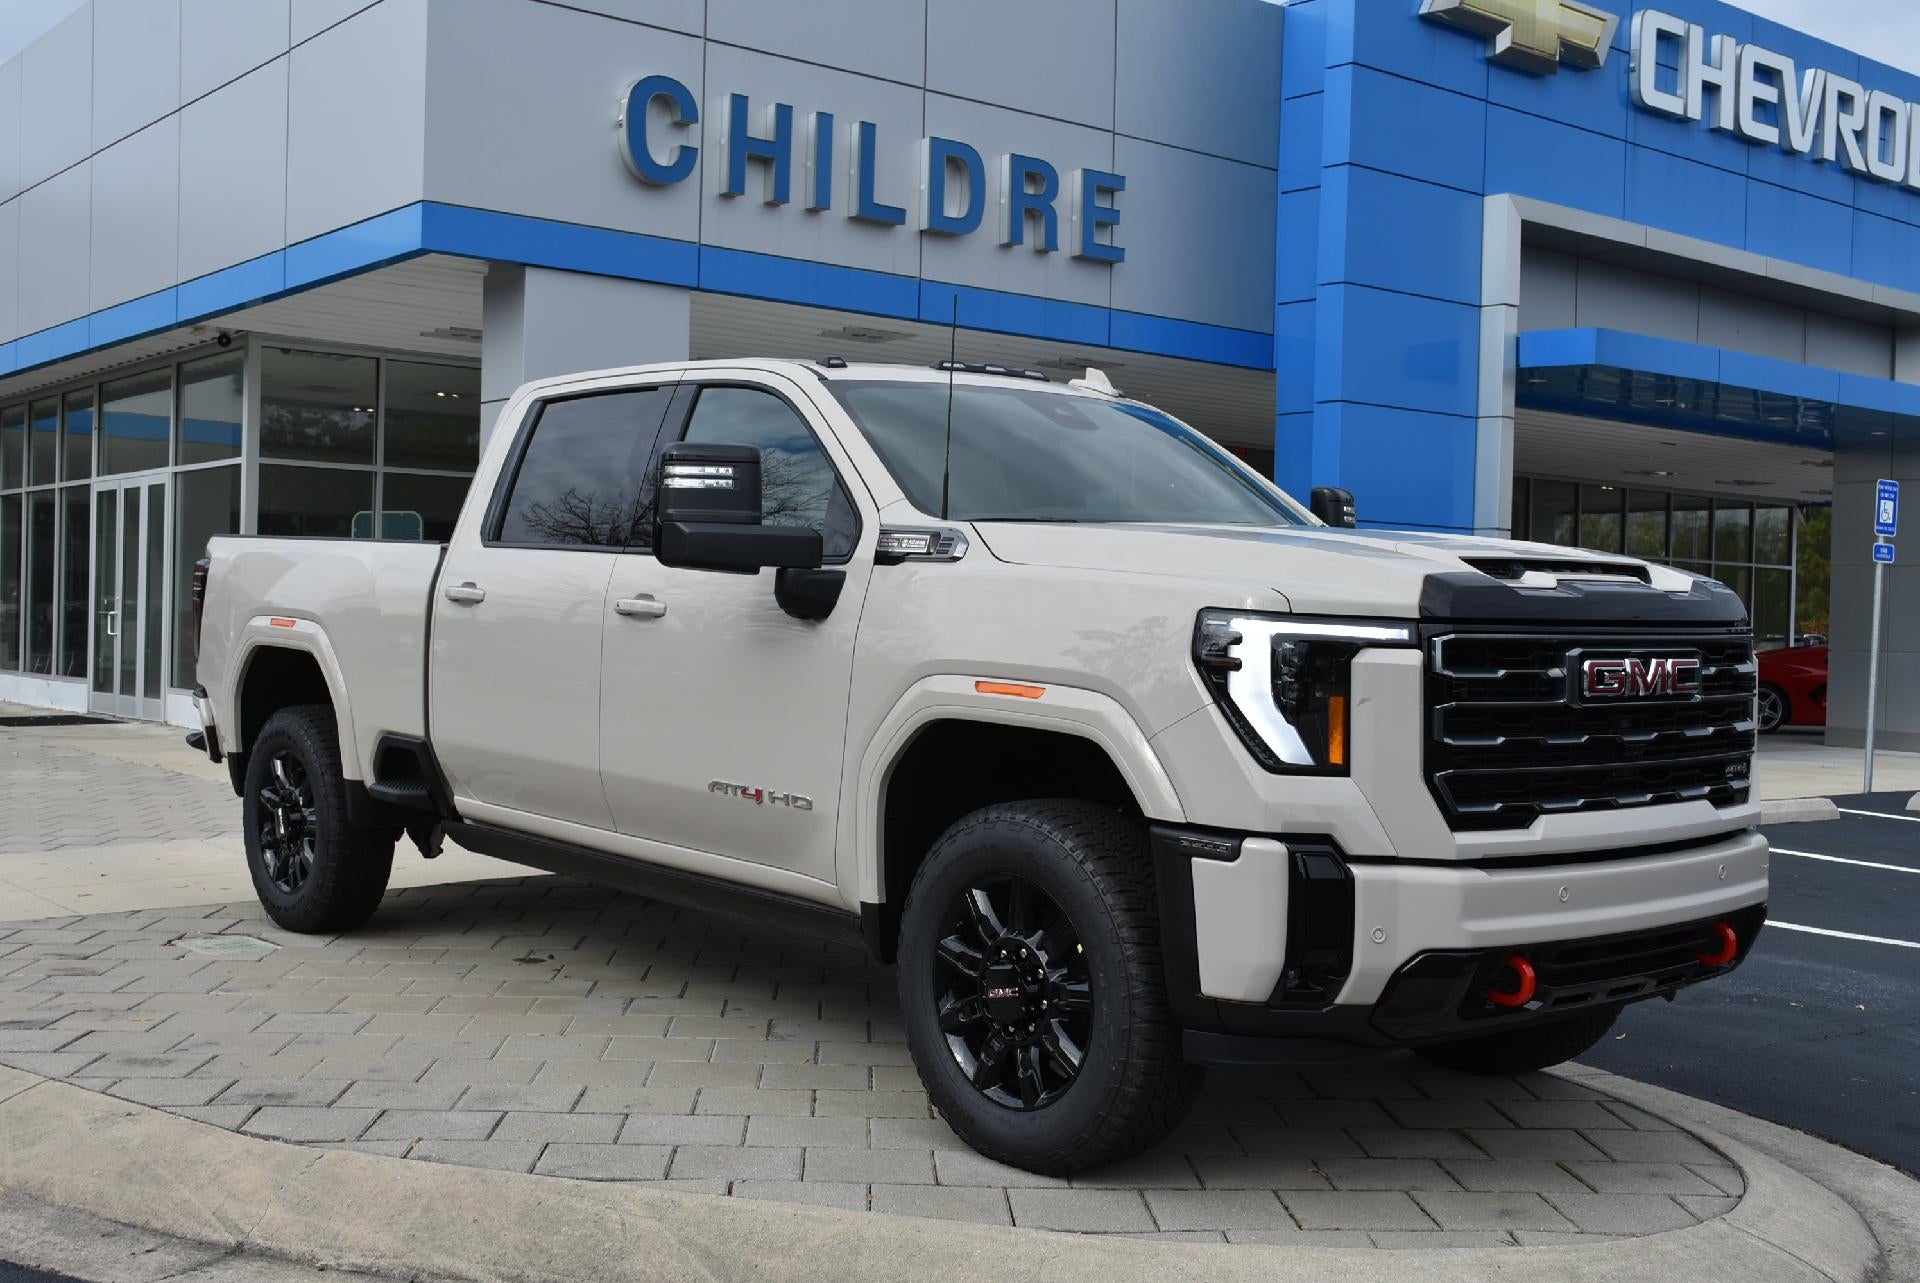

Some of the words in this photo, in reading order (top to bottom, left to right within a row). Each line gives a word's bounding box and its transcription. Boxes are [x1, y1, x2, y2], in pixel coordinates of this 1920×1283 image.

[620, 75, 1127, 263] CHILDRE
[1584, 658, 1699, 697] GMC
[988, 987, 1019, 999] GMC
